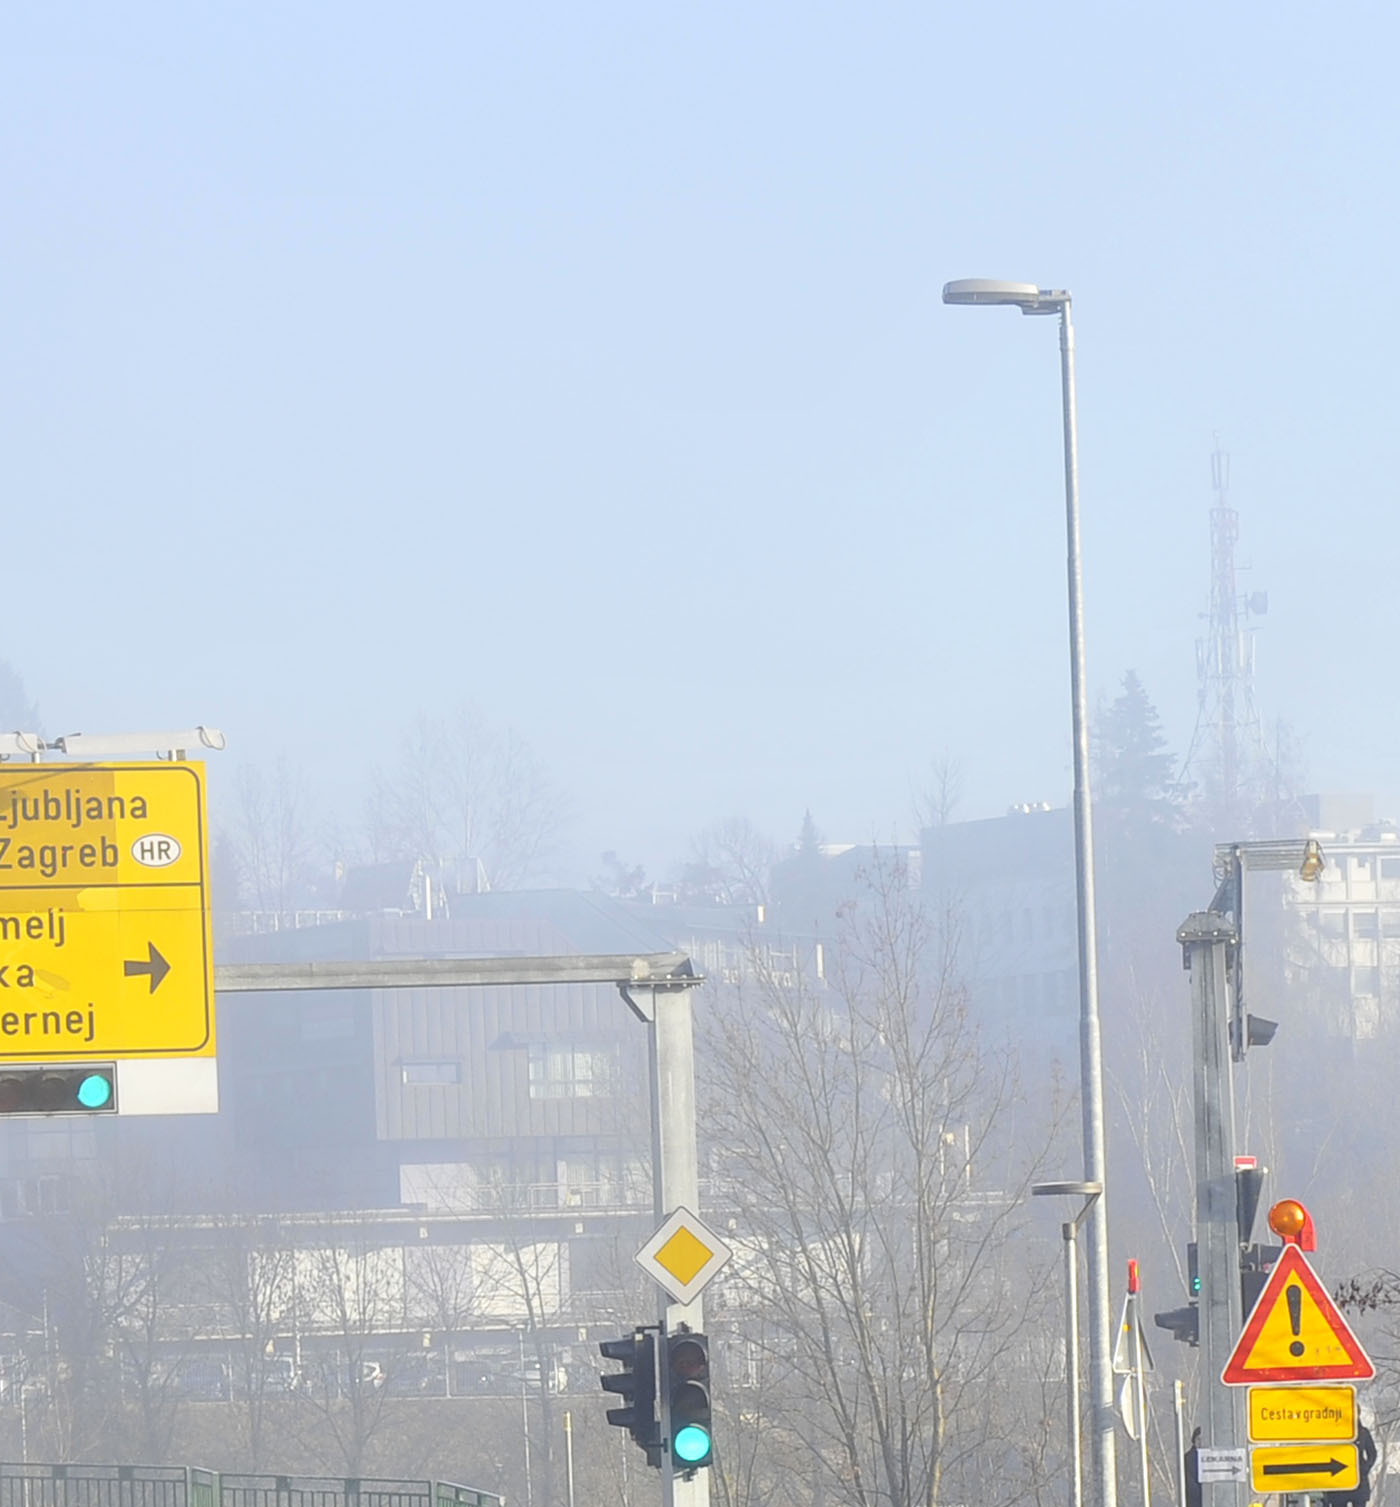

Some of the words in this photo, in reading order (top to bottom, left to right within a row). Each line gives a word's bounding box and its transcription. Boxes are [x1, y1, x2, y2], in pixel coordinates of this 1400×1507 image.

[139, 841, 171, 863] HR
[1261, 1407, 1294, 1420] Cesta
[1303, 1407, 1343, 1423] gradnji
